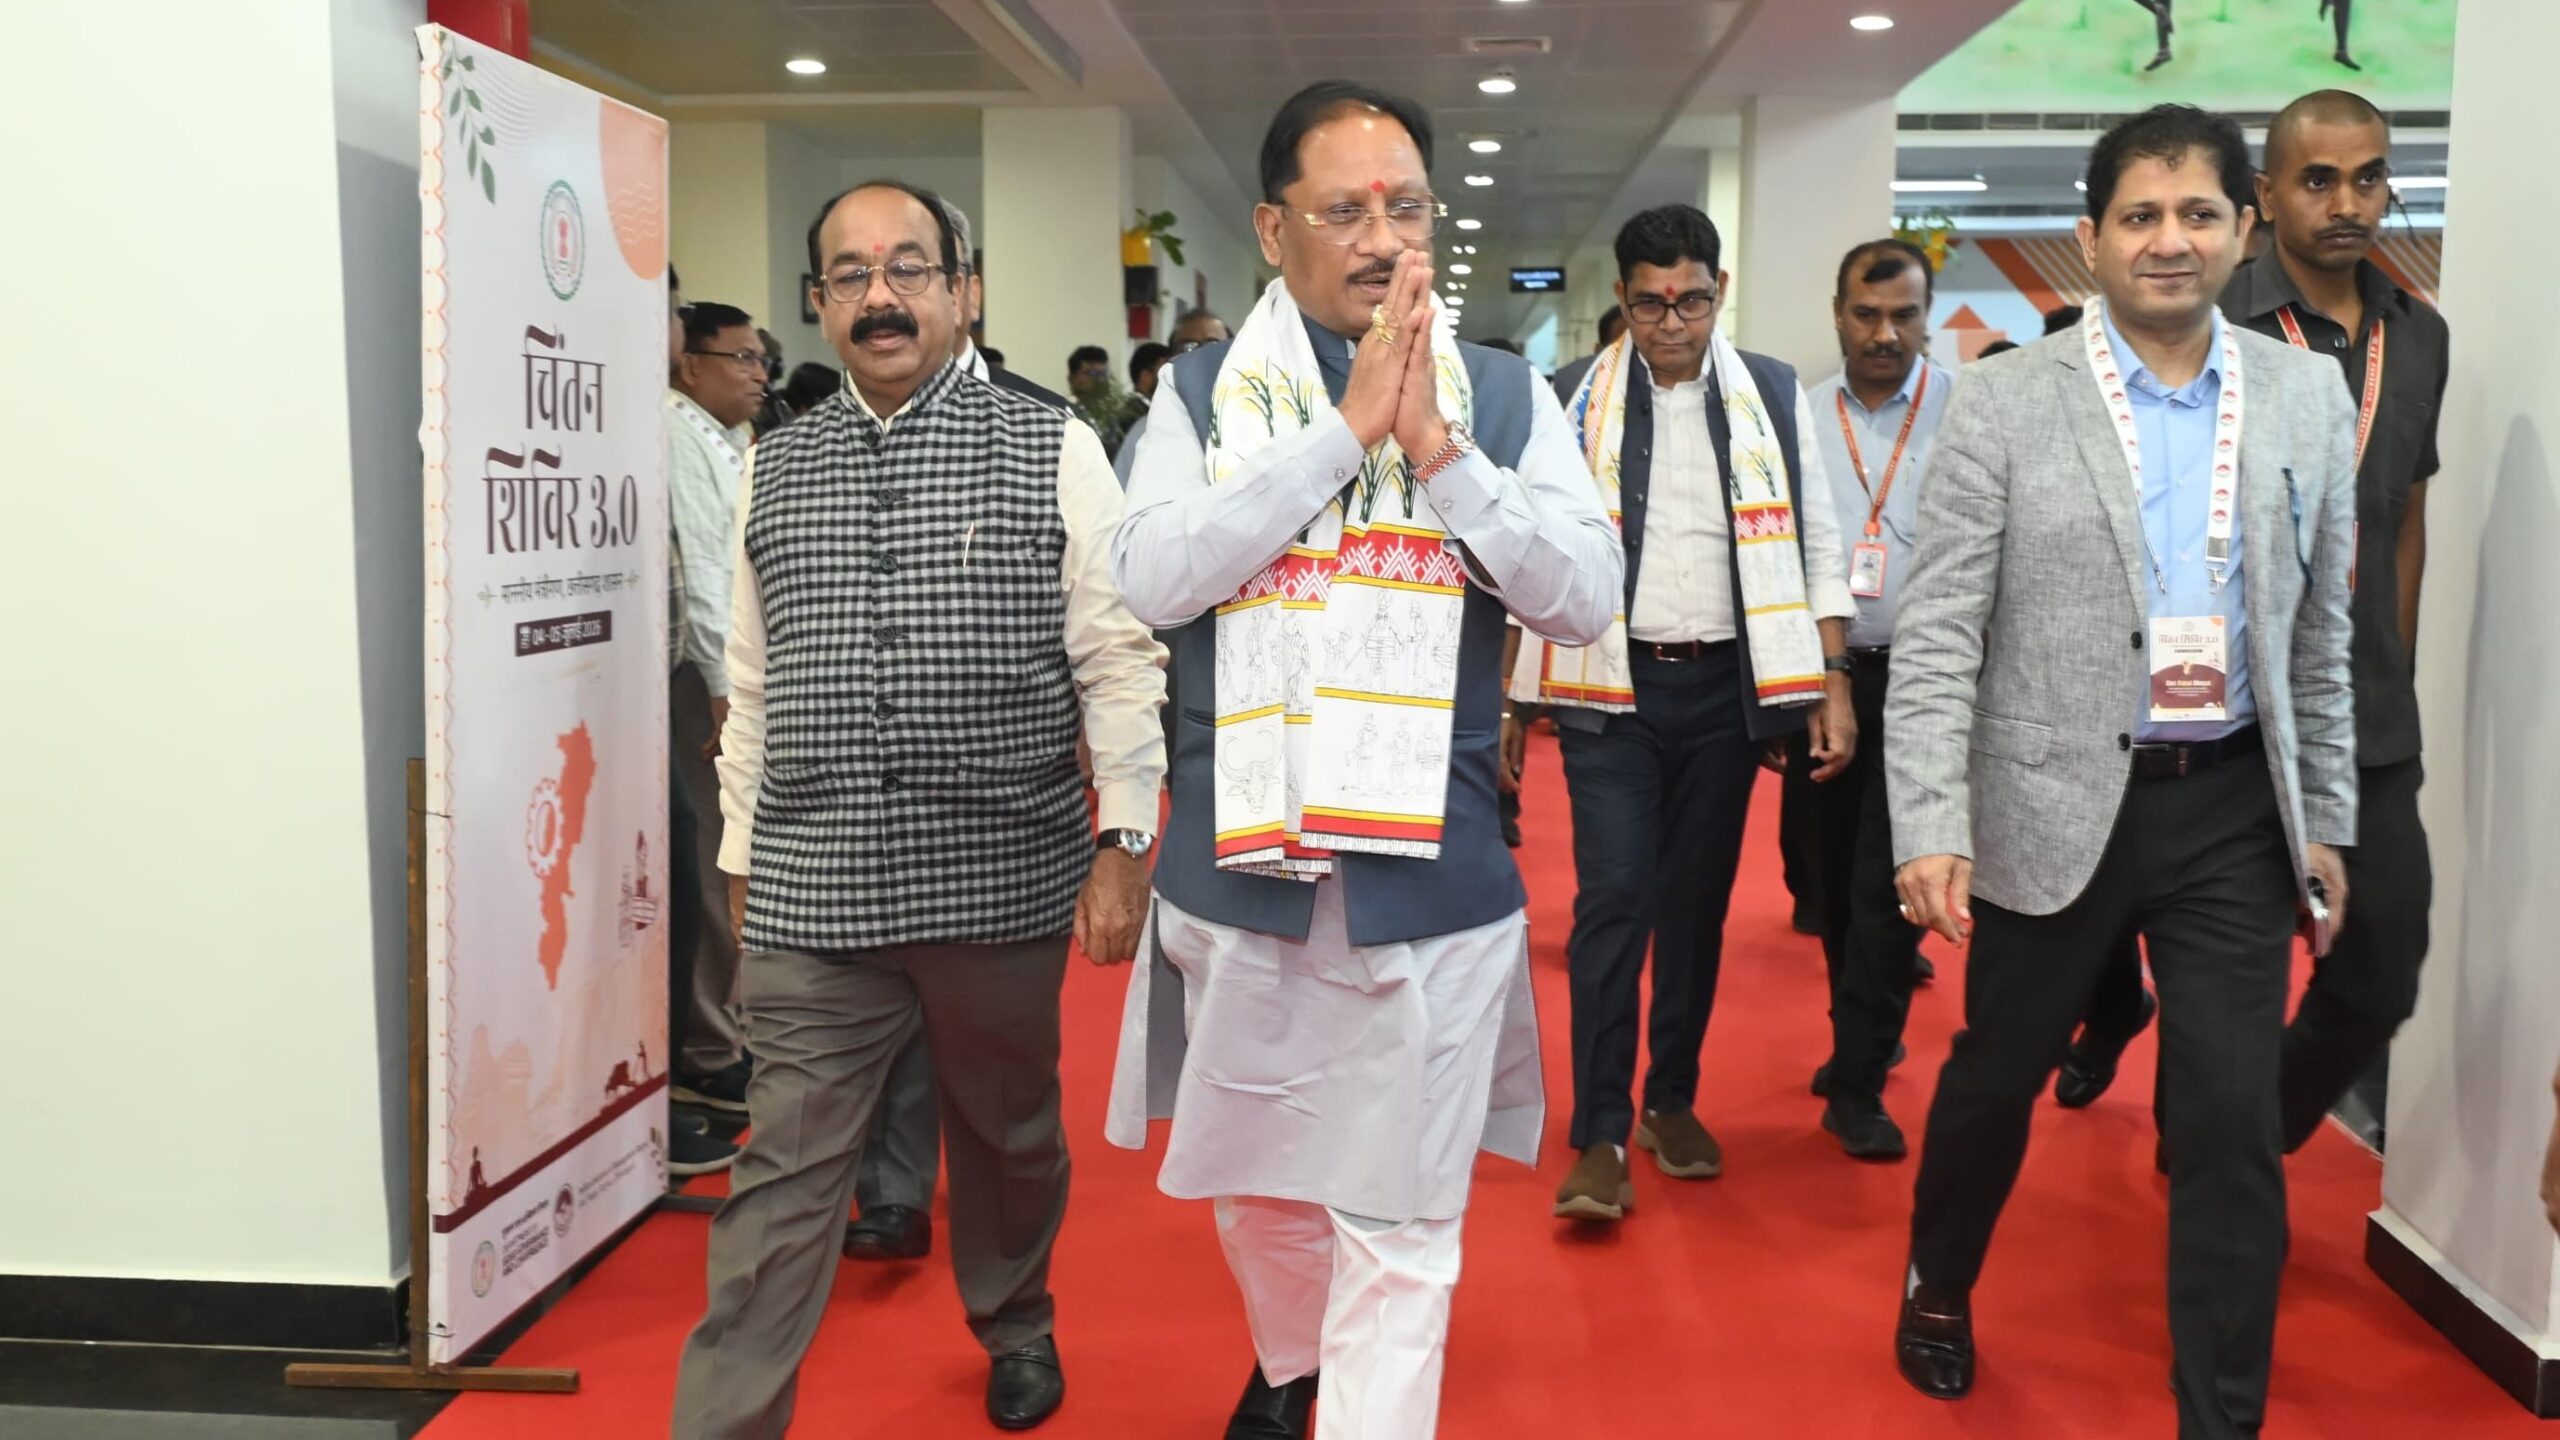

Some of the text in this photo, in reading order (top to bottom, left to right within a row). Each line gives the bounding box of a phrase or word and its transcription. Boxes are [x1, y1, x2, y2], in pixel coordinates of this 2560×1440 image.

[520, 323, 606, 433] चिंतन
[481, 442, 639, 555] शिविर 3.0
